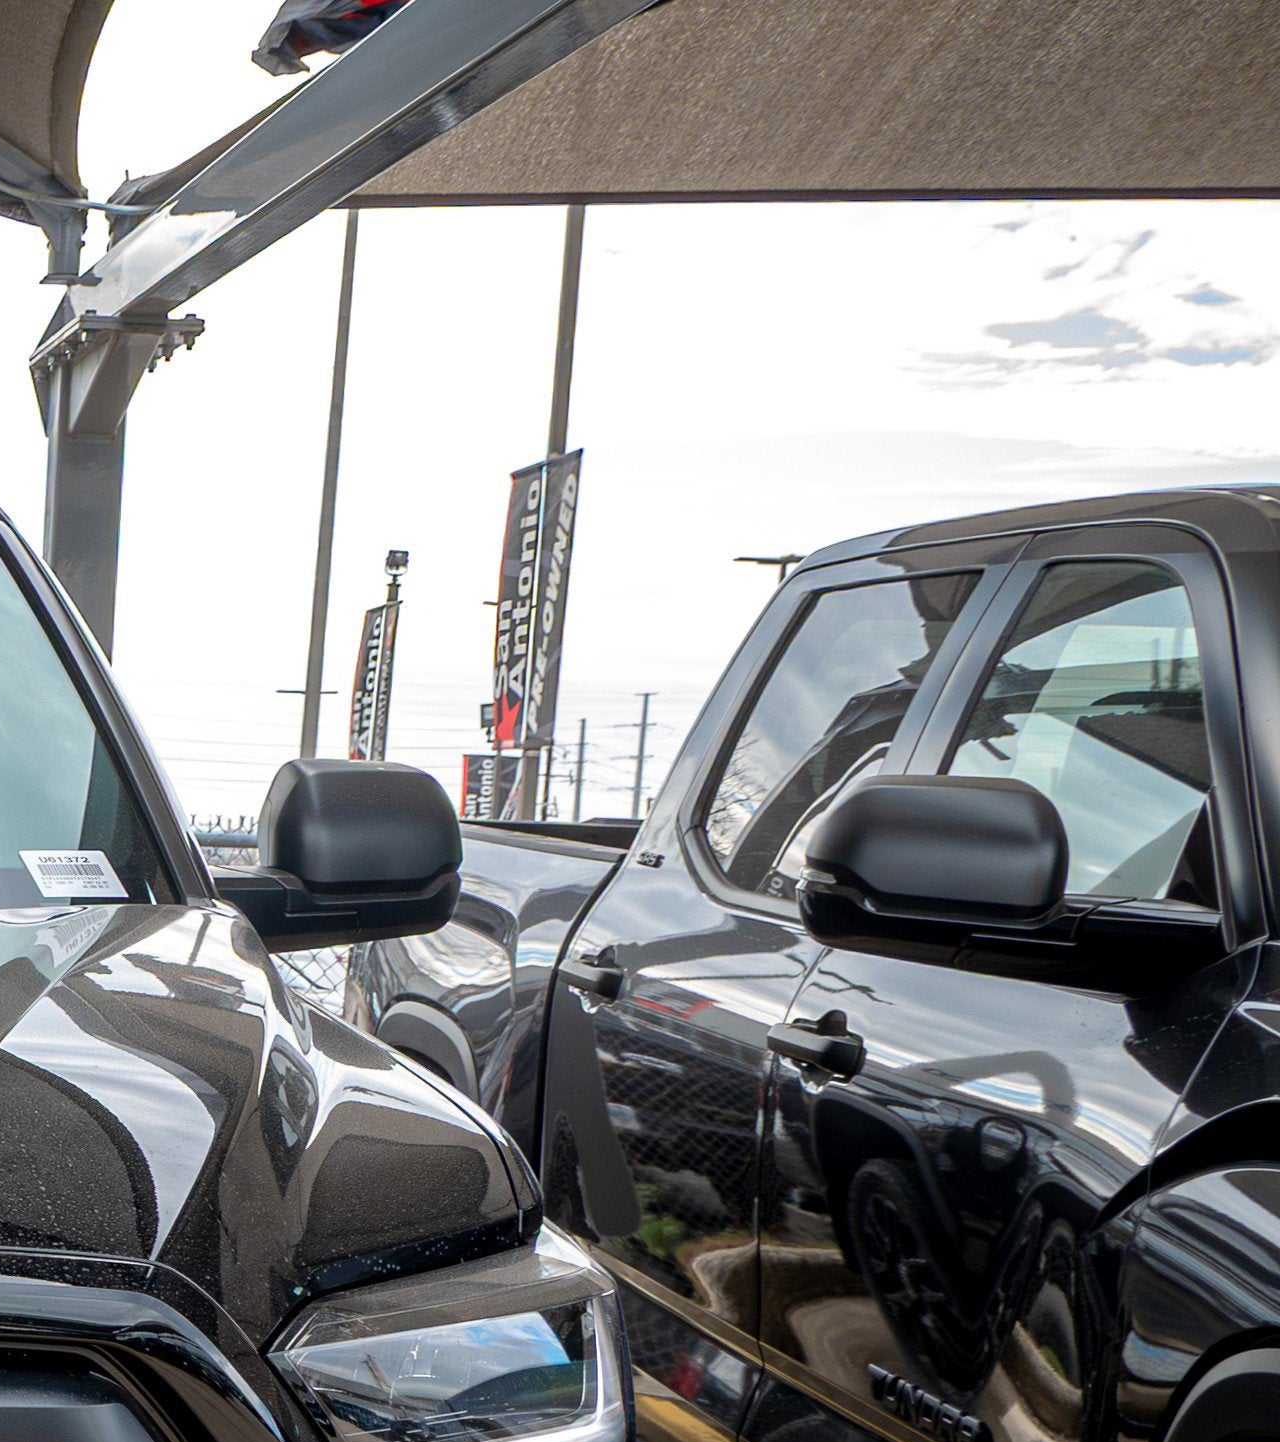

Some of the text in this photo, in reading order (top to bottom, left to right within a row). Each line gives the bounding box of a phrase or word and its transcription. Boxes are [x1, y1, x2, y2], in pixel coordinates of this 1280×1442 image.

[493, 600, 512, 699] San
[508, 479, 540, 698] Antonio
[526, 473, 577, 734] PRE-OWNED
